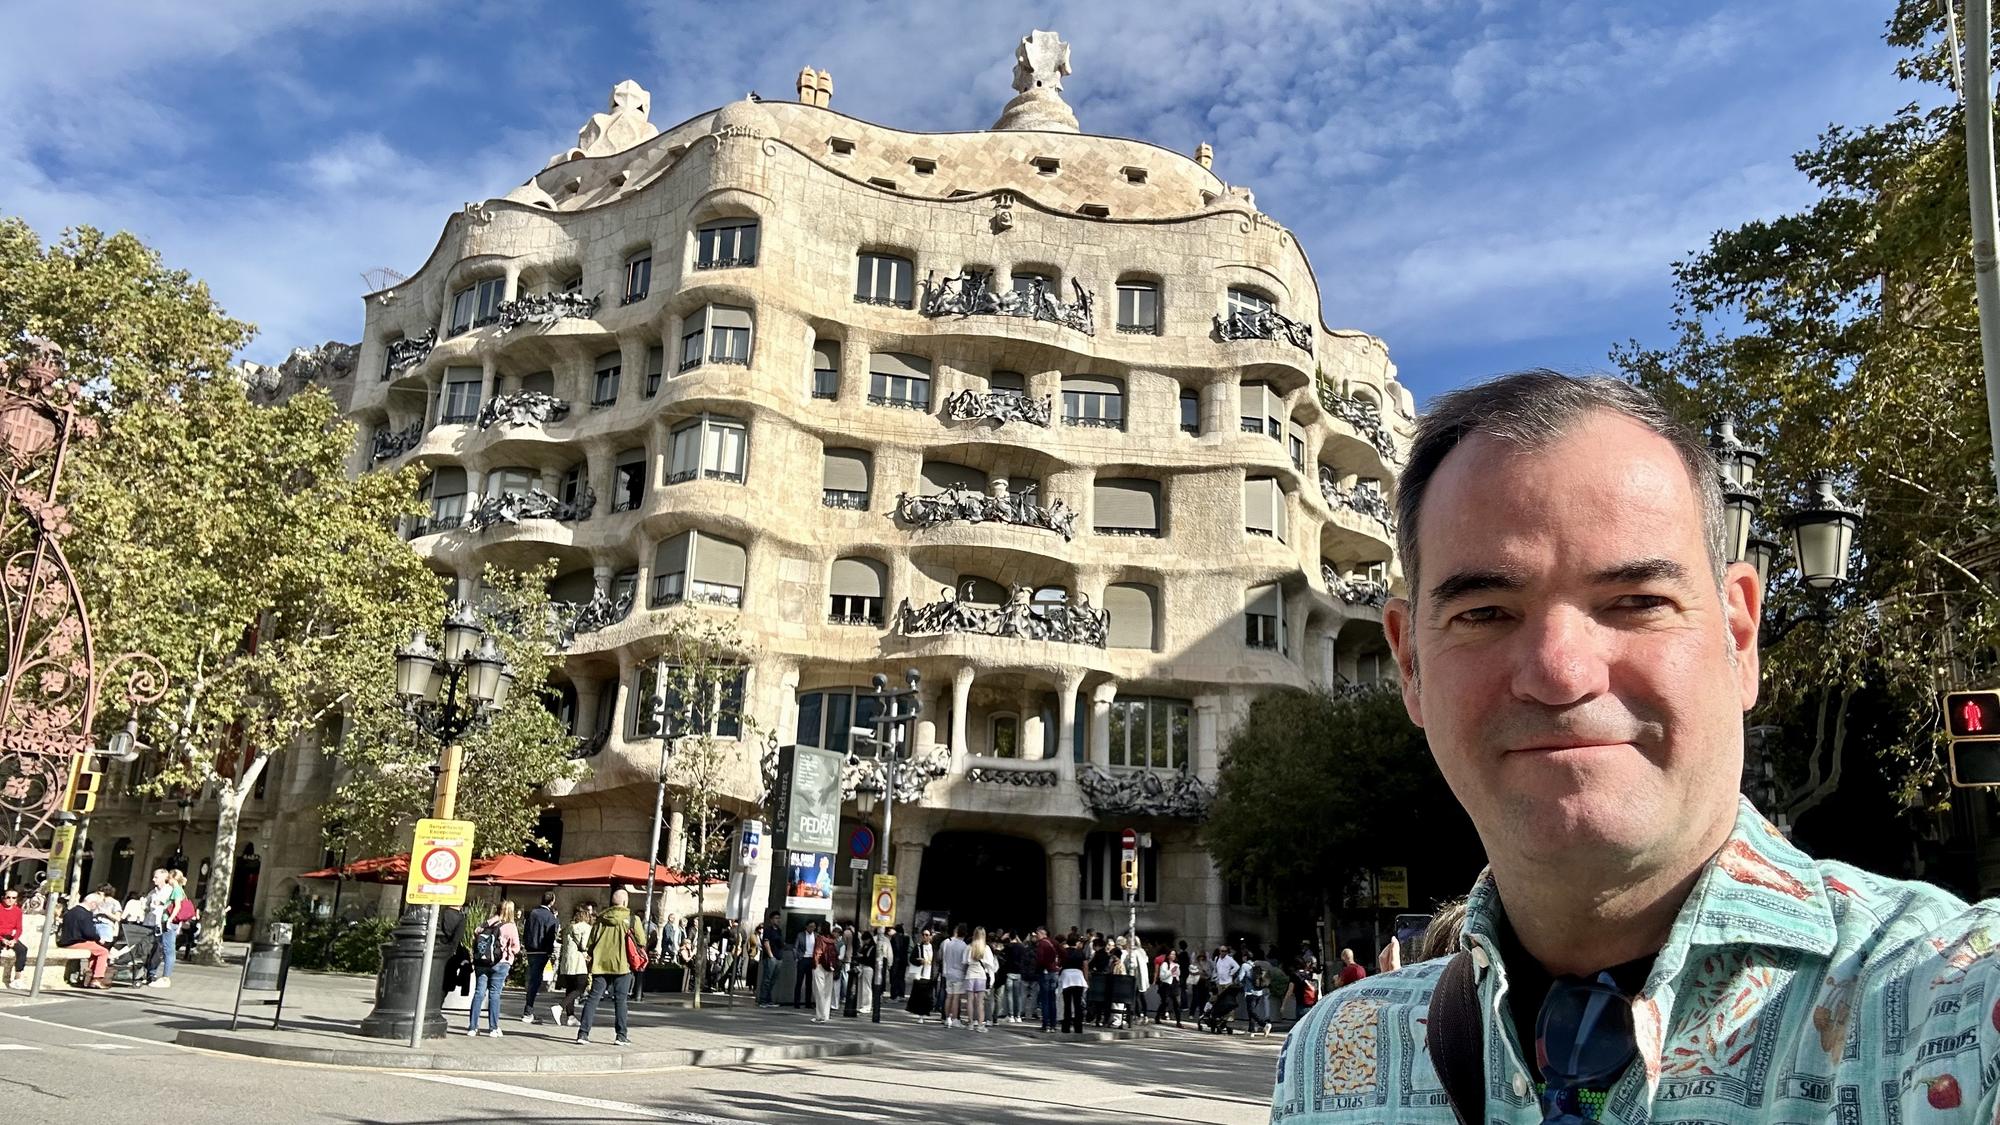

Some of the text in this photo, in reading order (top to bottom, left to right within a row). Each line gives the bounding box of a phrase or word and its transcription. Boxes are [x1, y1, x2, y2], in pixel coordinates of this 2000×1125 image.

[799, 815, 834, 836] PEDRA
[1663, 1080, 1716, 1099] SPICY
[1336, 1096, 1363, 1110] SPICY
